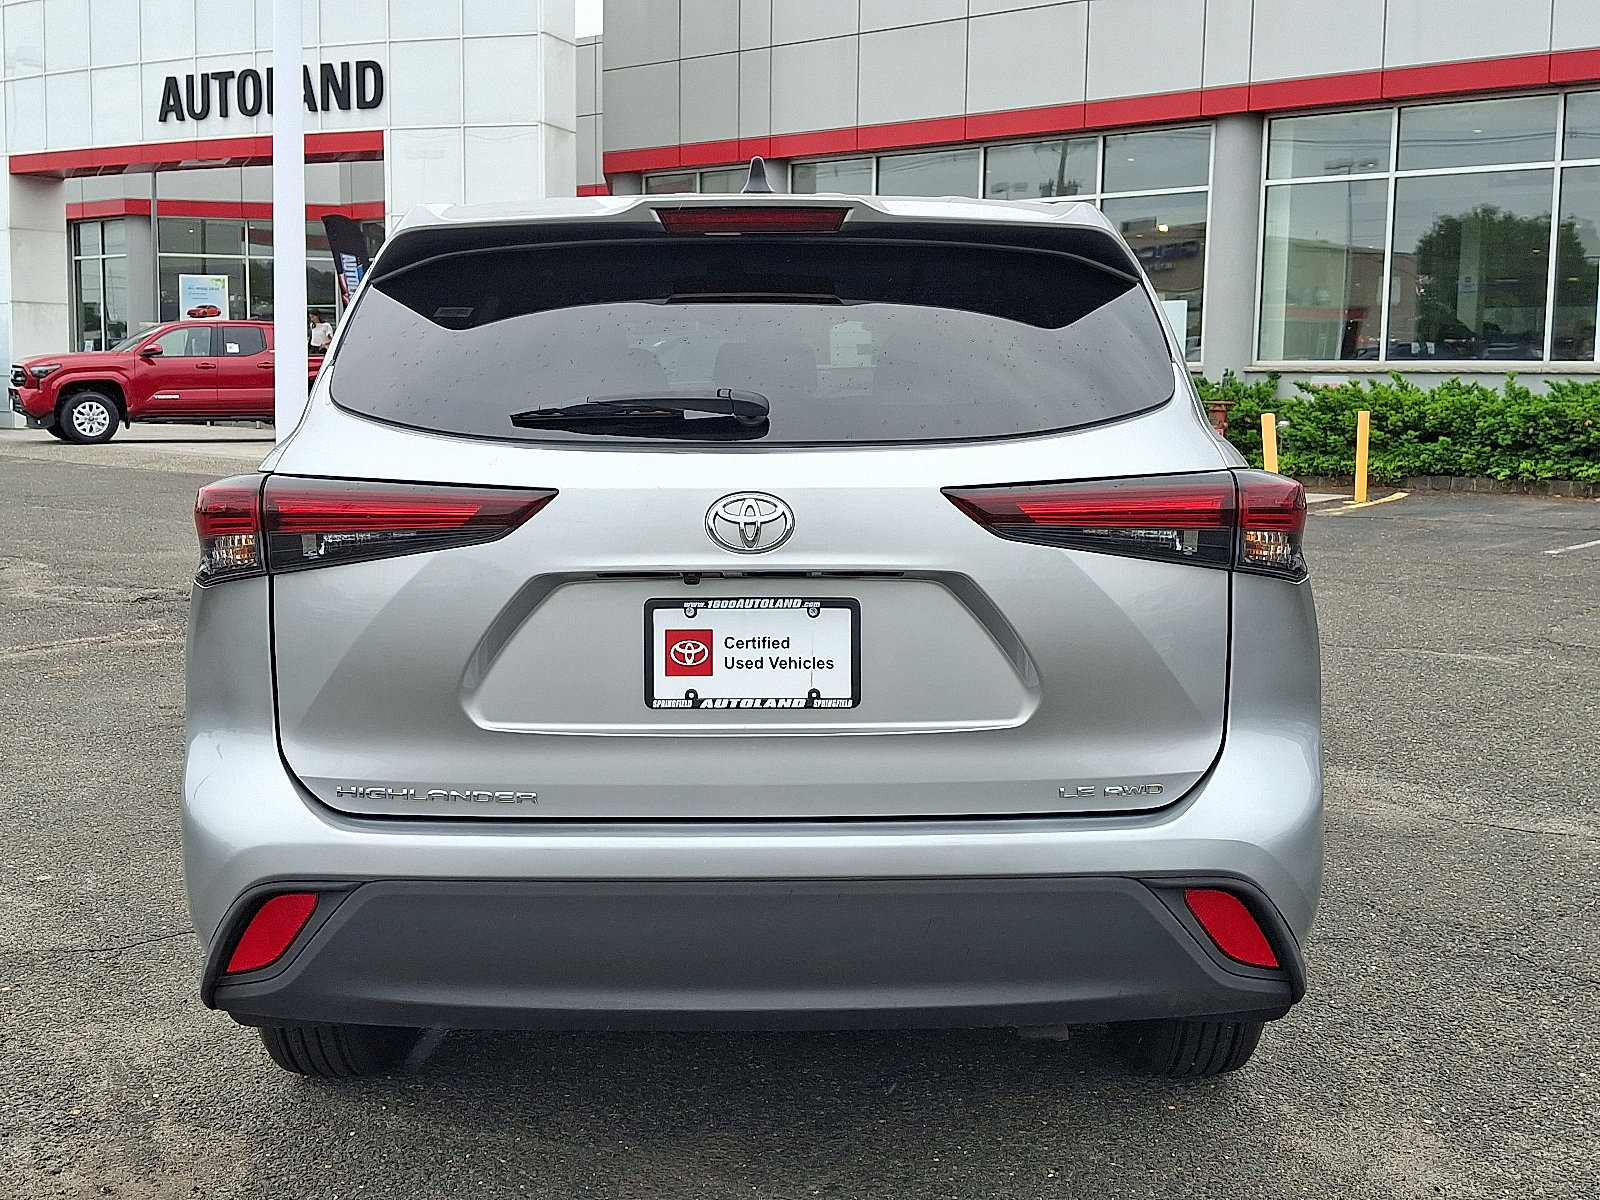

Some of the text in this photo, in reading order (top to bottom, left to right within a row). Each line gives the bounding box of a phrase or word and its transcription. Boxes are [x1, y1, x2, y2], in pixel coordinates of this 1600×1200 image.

[158, 60, 384, 122] AUTOAND
[724, 636, 790, 649] Certified
[724, 656, 835, 669] Used Vehicles
[652, 699, 853, 708] SPRINGFIELD AUTOLAND SPRINGFIELD
[337, 786, 538, 804] HIGHLANDER
[1059, 783, 1163, 798] LE AWD
